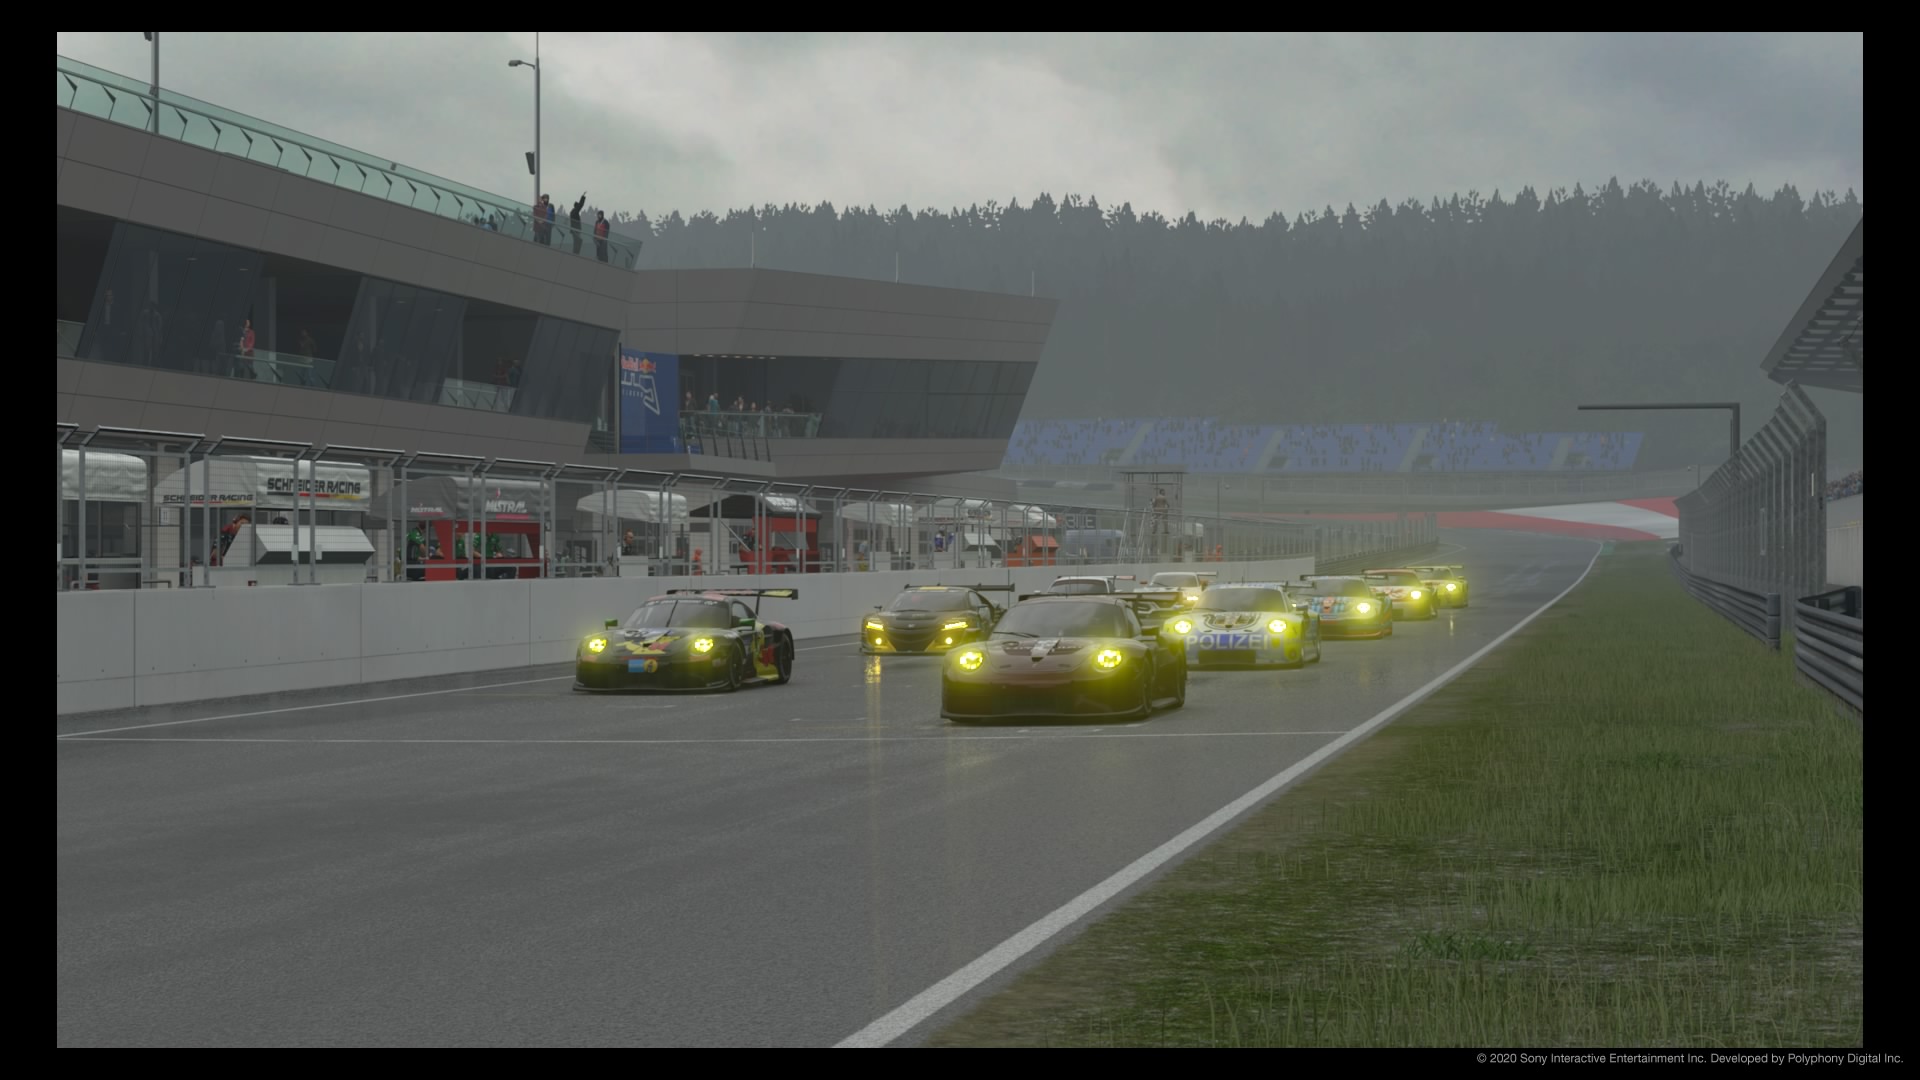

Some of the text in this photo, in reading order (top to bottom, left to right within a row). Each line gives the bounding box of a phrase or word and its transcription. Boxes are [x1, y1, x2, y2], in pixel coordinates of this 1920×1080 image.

[327, 480, 361, 495] RACING
[163, 494, 254, 502] SCHEIDR RACING
[1185, 634, 1268, 650] POLIZEI
